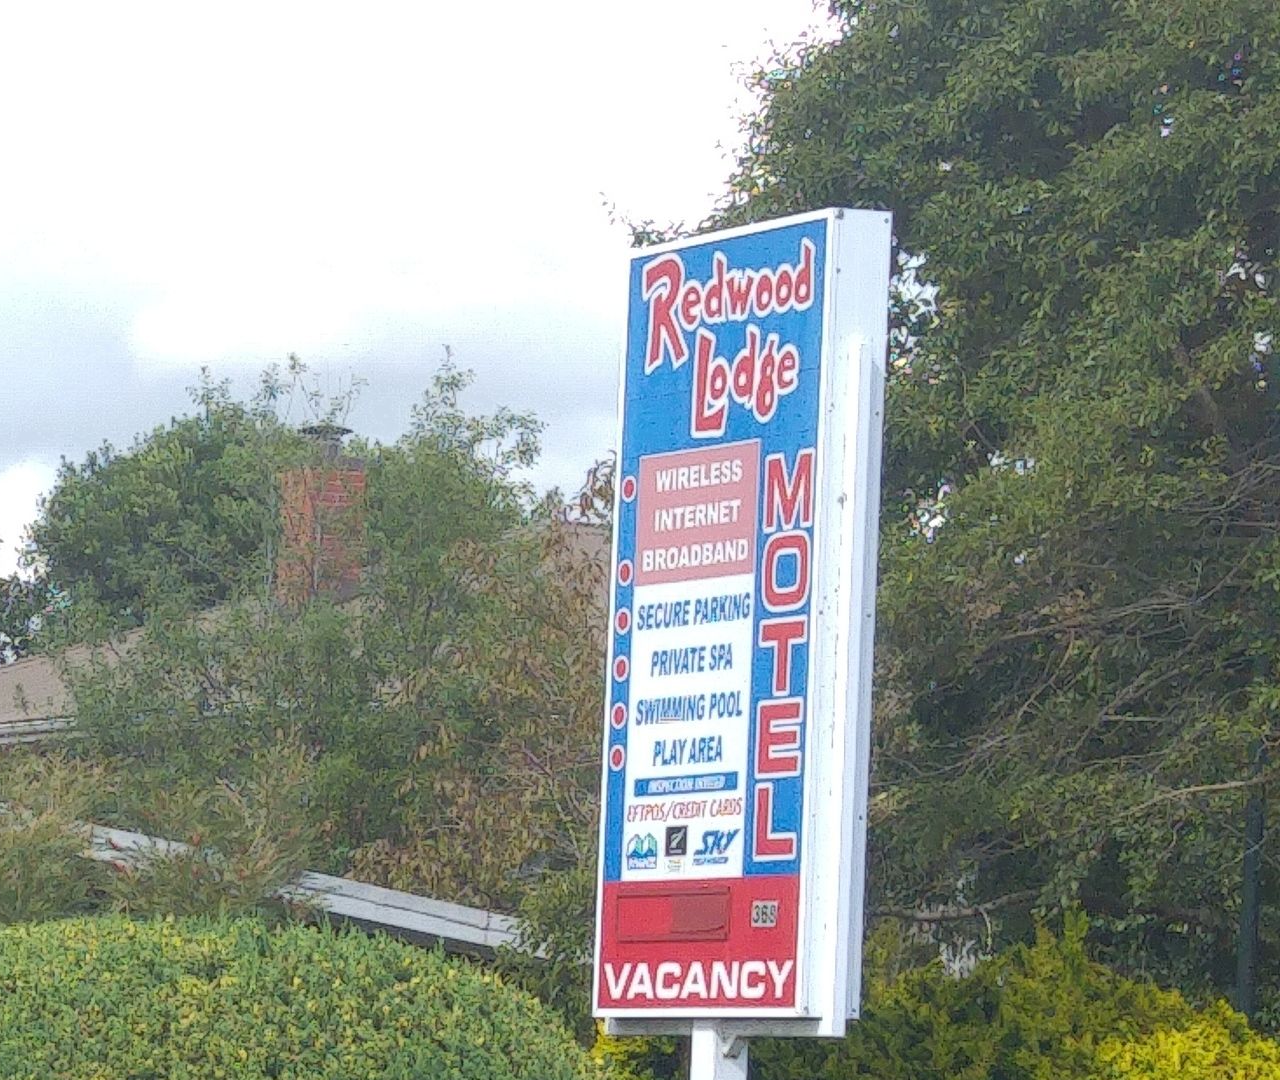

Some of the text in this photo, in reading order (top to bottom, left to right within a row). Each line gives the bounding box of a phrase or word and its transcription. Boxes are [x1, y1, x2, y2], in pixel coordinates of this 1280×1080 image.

[643, 238, 814, 374] Redwood
[690, 325, 799, 439] Lodge
[653, 459, 744, 492] WIRELESS
[653, 498, 743, 532] INTERNET
[640, 538, 749, 572] BROADBAND
[637, 592, 751, 631] SECURE PARKING
[650, 642, 733, 677] PRIVATE SPA
[753, 450, 814, 862] MOTEL
[635, 690, 743, 726] SWIMMING POOL
[652, 735, 723, 767] PLAY AREA
[710, 797, 743, 817] CARDS
[694, 828, 741, 855] SKY
[603, 957, 794, 1000] VACANCY
